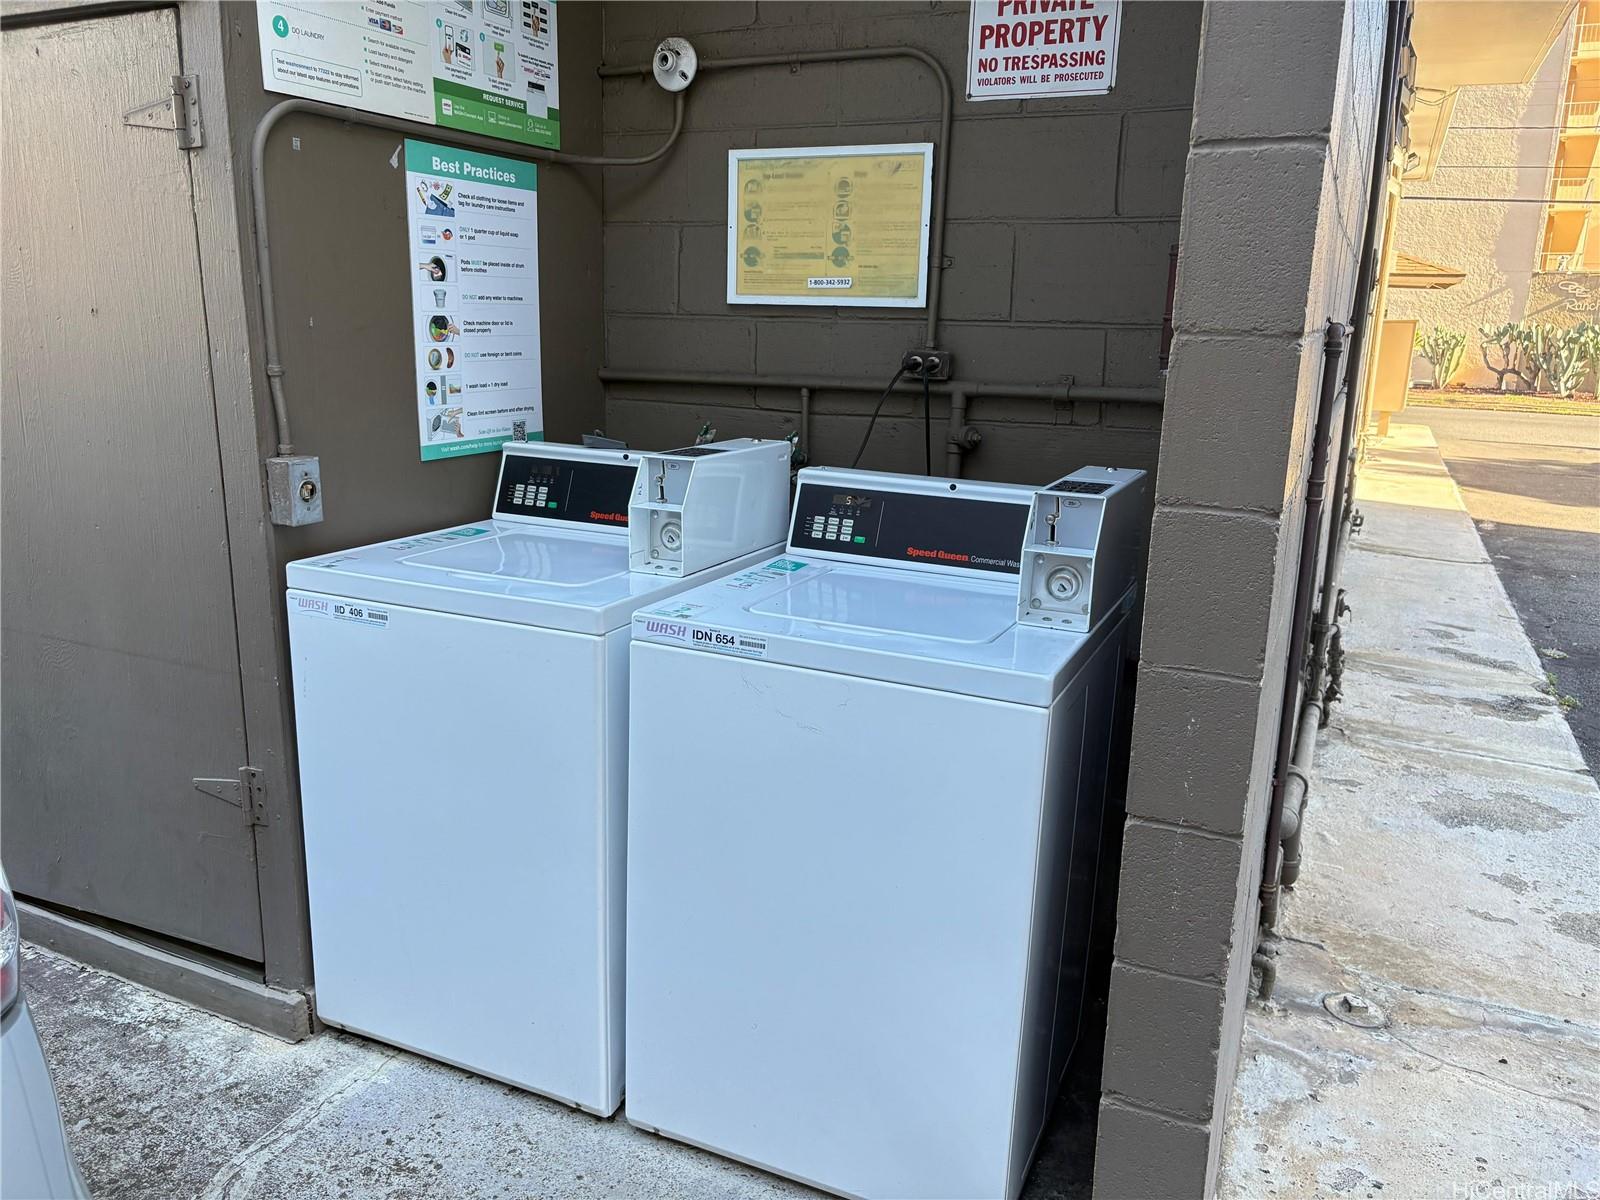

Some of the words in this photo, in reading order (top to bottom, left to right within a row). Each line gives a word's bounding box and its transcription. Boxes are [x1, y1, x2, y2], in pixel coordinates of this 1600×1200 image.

[278, 20, 284, 32] 4
[300, 29, 324, 40] LAUNDRY
[979, 14, 1109, 50] PROPERTY
[978, 57, 998, 73] NO
[1002, 50, 1106, 72] TRESPASSING
[977, 76, 1016, 86] VIOLATORS
[1020, 74, 1038, 85] WILL
[1040, 74, 1051, 82] BE
[1054, 71, 1104, 82] PROSECUTED
[482, 93, 505, 104] REQUEST
[505, 98, 525, 110] SERVICE
[432, 156, 460, 174] Best
[463, 160, 516, 183] Practices
[471, 202, 485, 210] laundry
[590, 510, 614, 520] Speed
[615, 514, 628, 522] Que
[906, 546, 936, 558] Speed
[938, 550, 968, 562] Queen
[970, 555, 1006, 566] Commercial
[1006, 560, 1020, 568] Was
[298, 598, 328, 612] WASH
[348, 608, 364, 618] 406
[646, 620, 686, 637] WASH
[692, 629, 712, 642] IDN
[715, 633, 735, 646] 654
